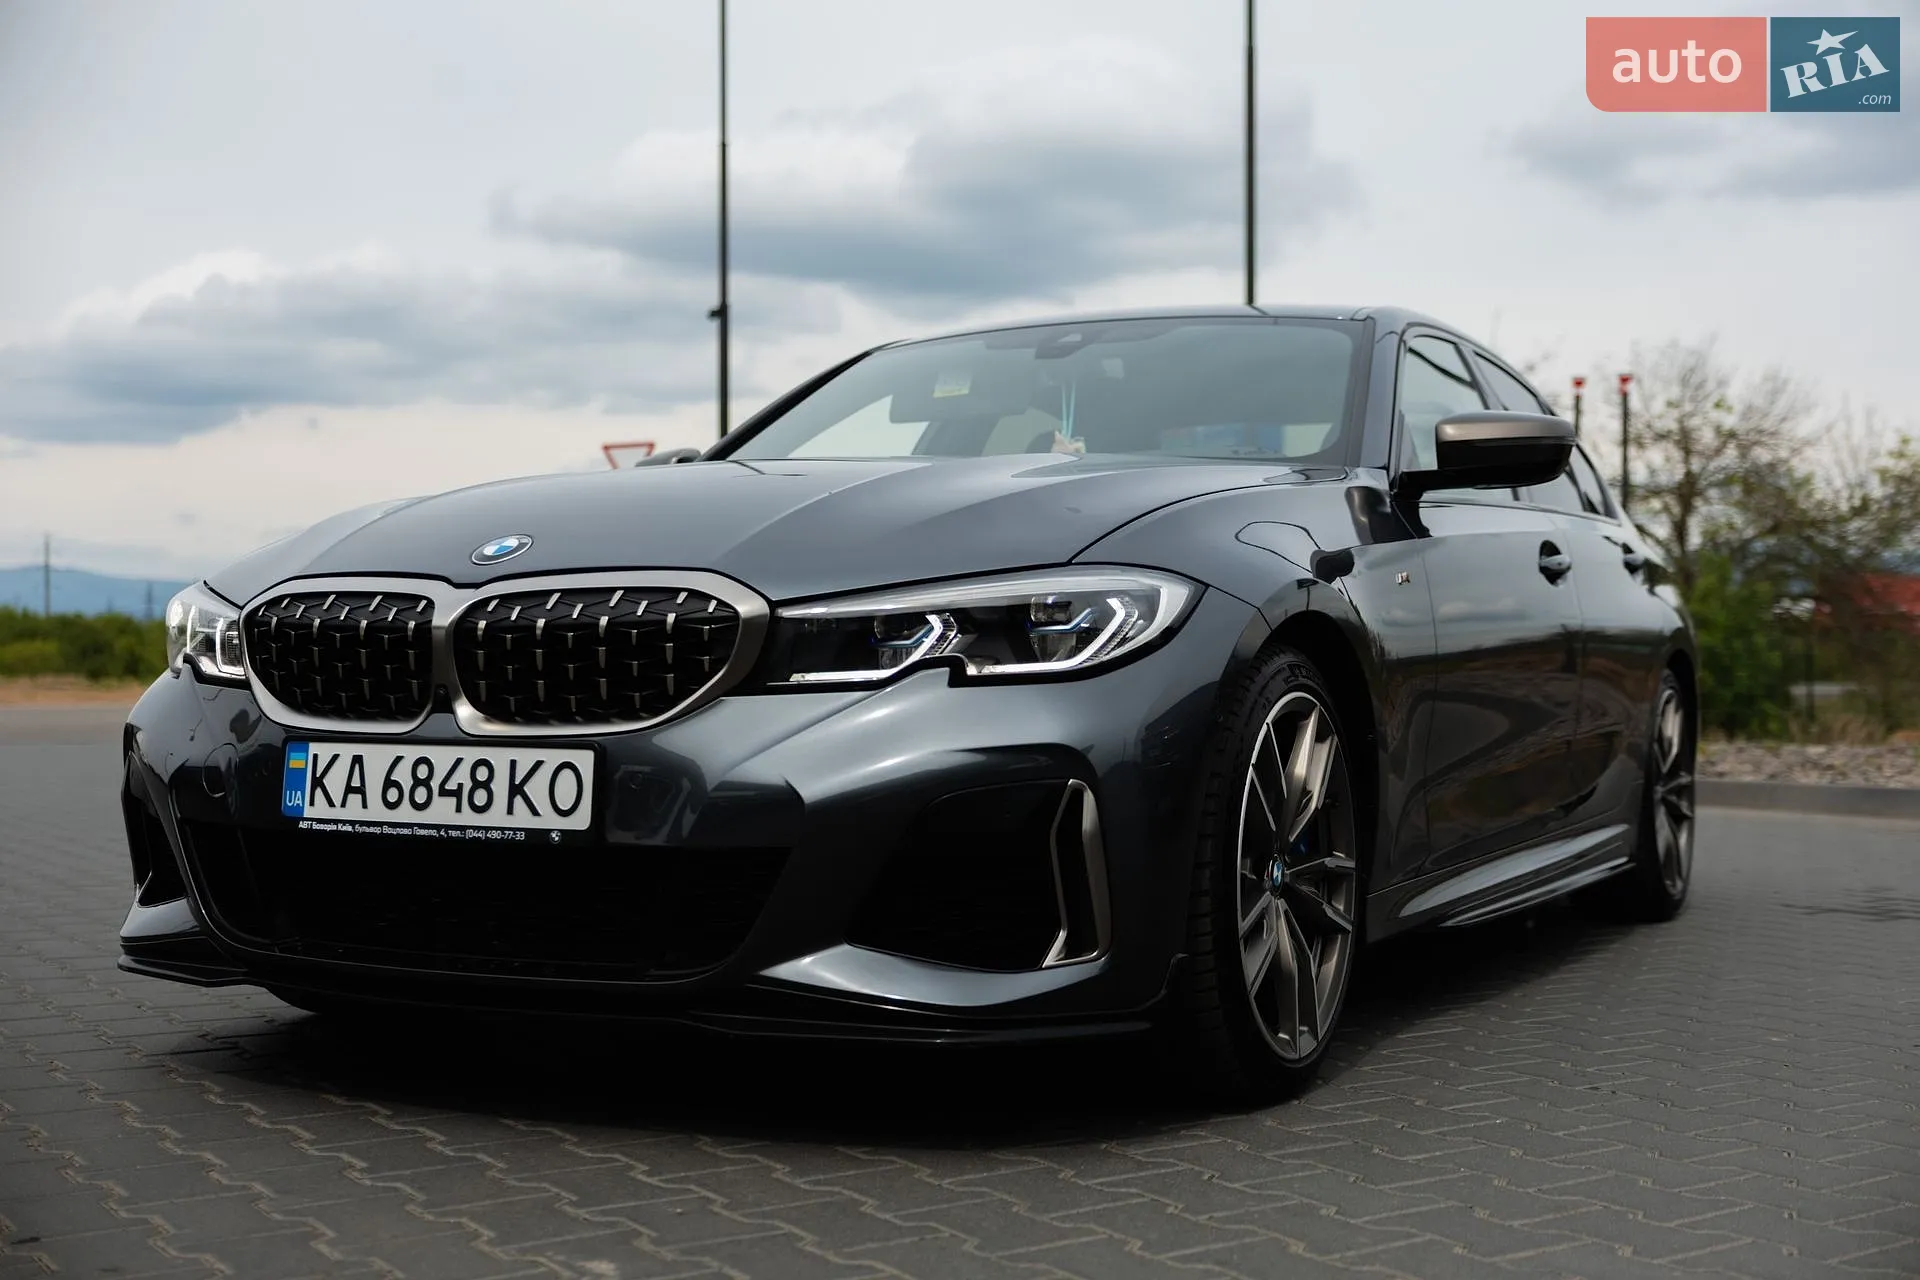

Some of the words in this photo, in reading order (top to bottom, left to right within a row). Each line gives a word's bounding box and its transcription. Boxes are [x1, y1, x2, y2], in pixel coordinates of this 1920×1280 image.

[381, 754, 495, 814] 6848
[506, 758, 584, 818] KO
[286, 790, 303, 807] UA
[466, 829, 486, 840] (044)
[486, 830, 525, 841] 490-77-33
